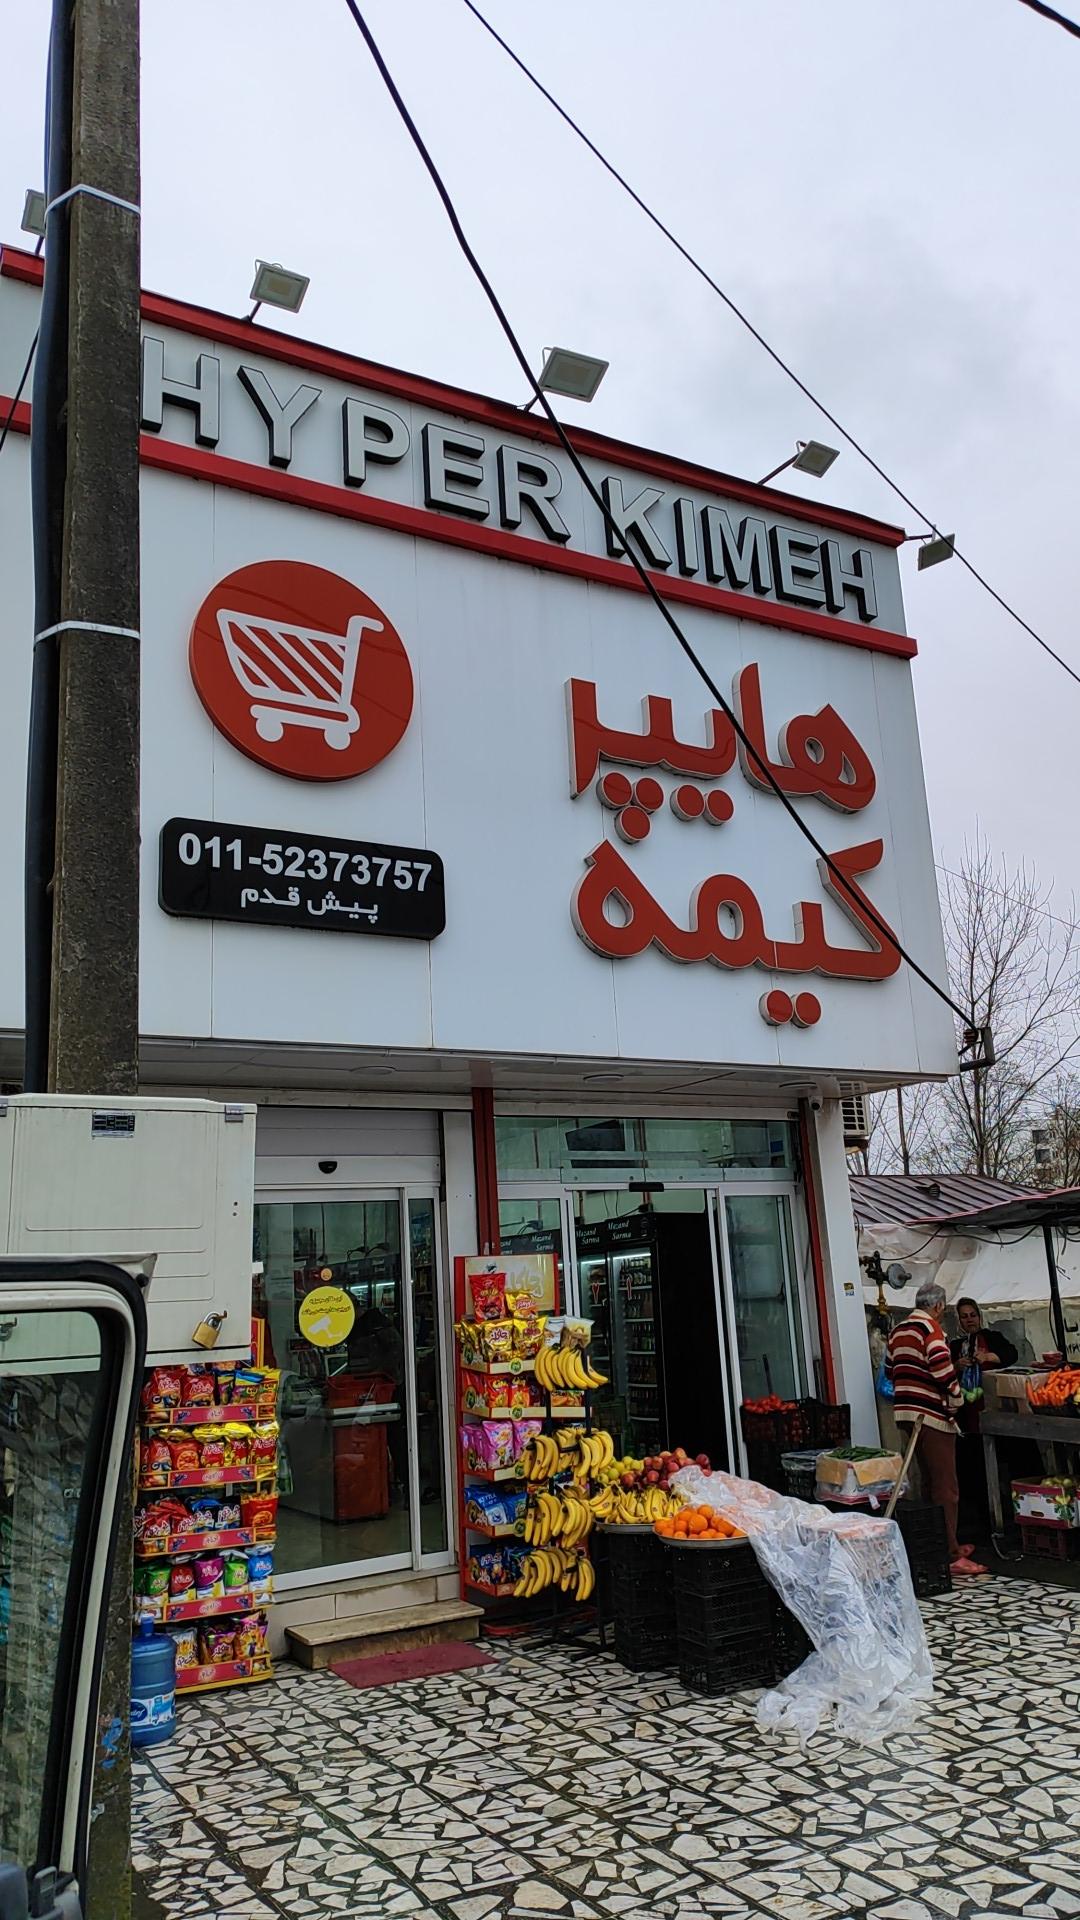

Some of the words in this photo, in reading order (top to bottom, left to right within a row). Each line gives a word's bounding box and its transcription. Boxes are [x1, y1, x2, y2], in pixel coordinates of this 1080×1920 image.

[140, 335, 571, 543] HYPER
[600, 475, 879, 623] KIMEH
[563, 661, 878, 845] هایپر
[177, 832, 433, 893] 011-52373757
[240, 885, 300, 909] قدم
[306, 889, 379, 925] پیش
[569, 837, 903, 1029] کیمه
